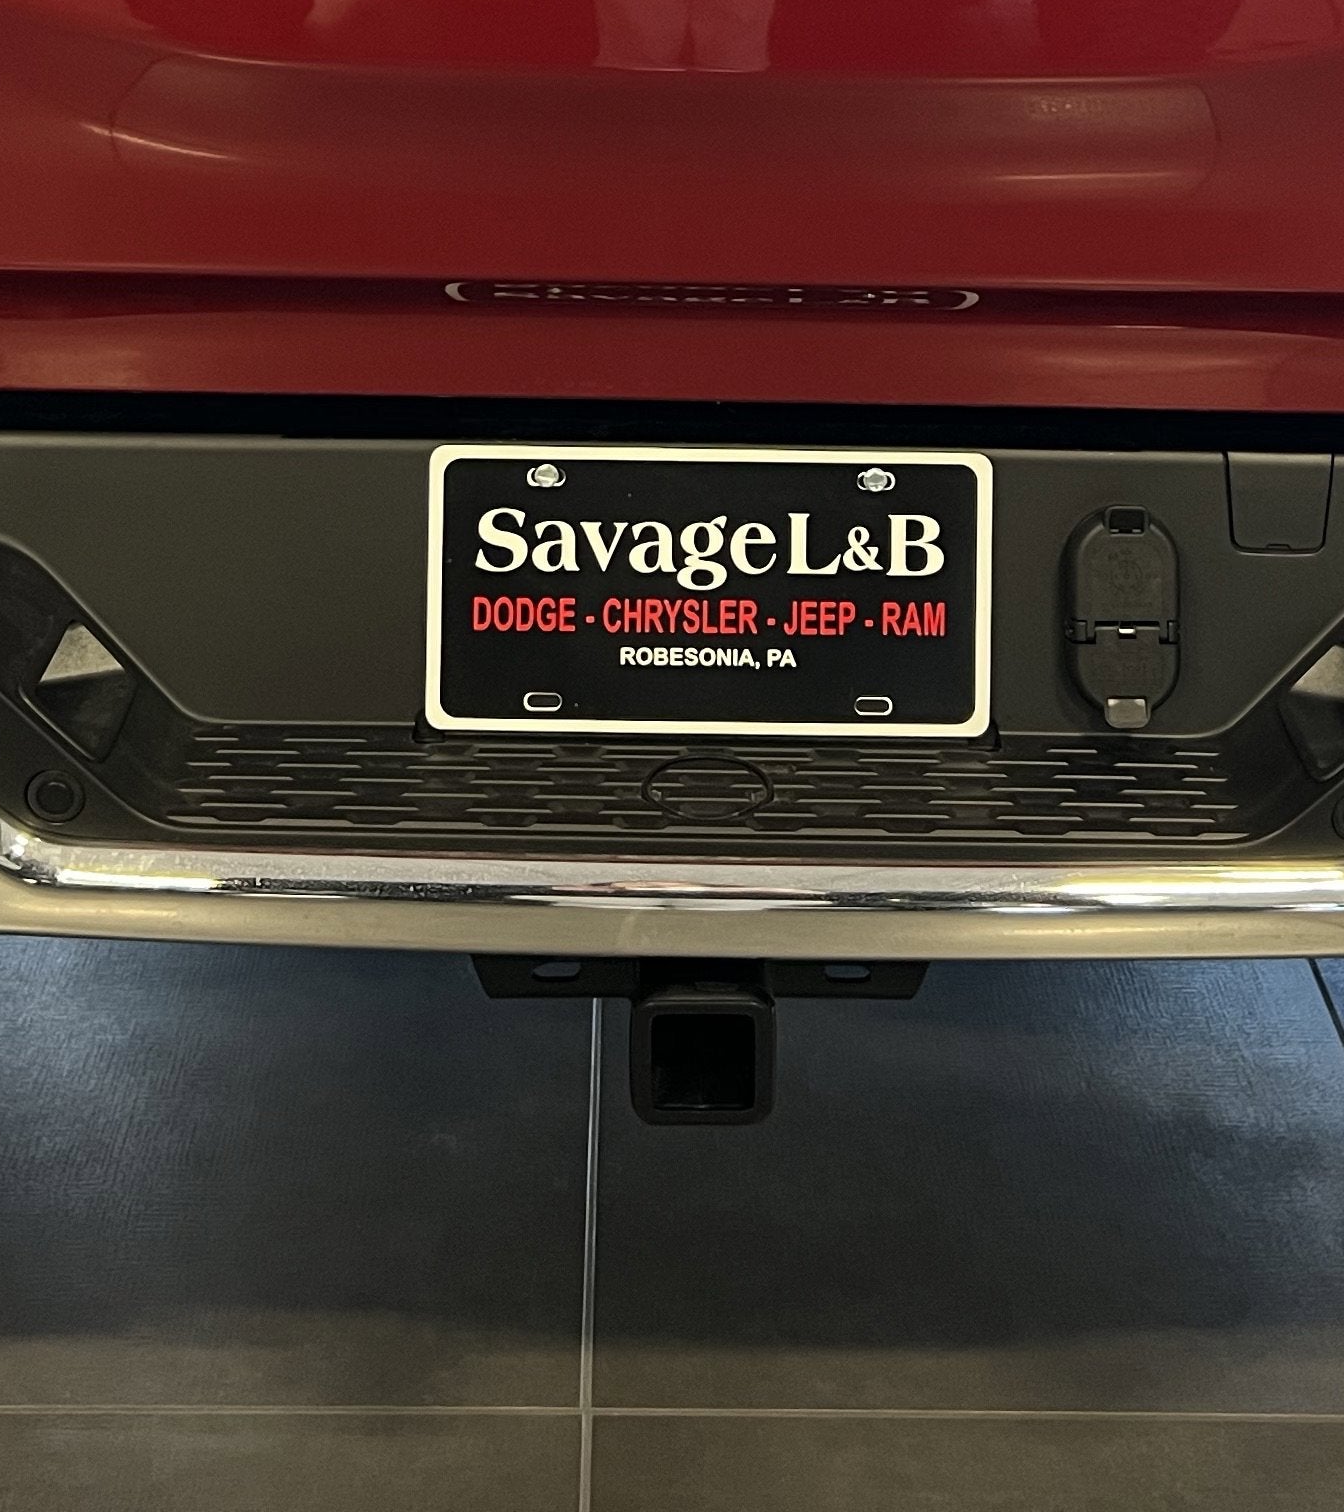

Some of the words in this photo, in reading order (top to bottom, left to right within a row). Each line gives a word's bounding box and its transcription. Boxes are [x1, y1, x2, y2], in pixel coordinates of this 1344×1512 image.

[474, 507, 777, 591] Savage
[786, 511, 946, 577] L&B
[472, 595, 577, 633] DODGE
[601, 597, 759, 636] CHRYSLER
[782, 599, 857, 636] JEEP
[881, 601, 947, 637] RAM
[618, 646, 761, 669] ROBESONIA,
[766, 649, 797, 668] PA
